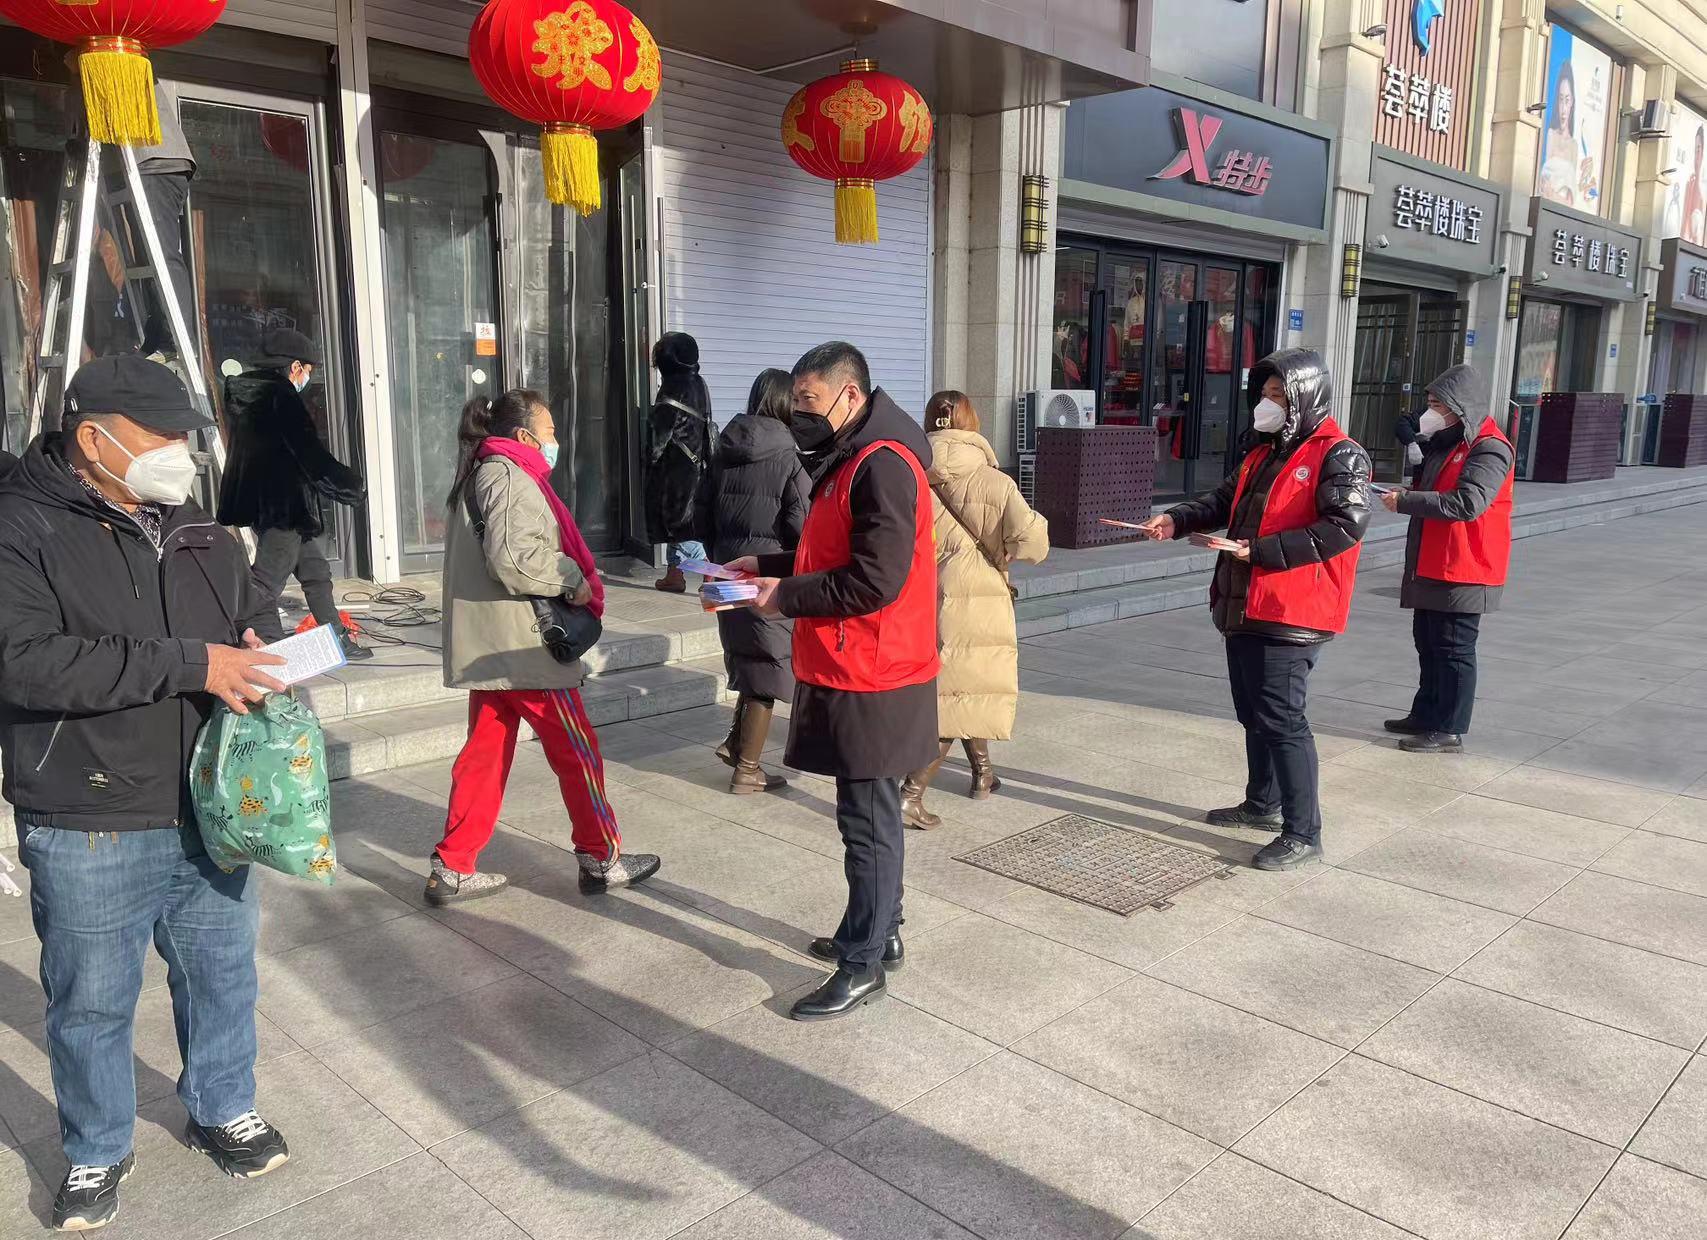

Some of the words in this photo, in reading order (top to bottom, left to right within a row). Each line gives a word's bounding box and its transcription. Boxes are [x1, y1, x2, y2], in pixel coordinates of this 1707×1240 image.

[1383, 64, 1452, 133] 荟萃楼
[1212, 149, 1273, 196] 特步
[1396, 184, 1483, 244] 荟萃楼珠宝
[1553, 228, 1631, 278] 荟萃楼珠宝
